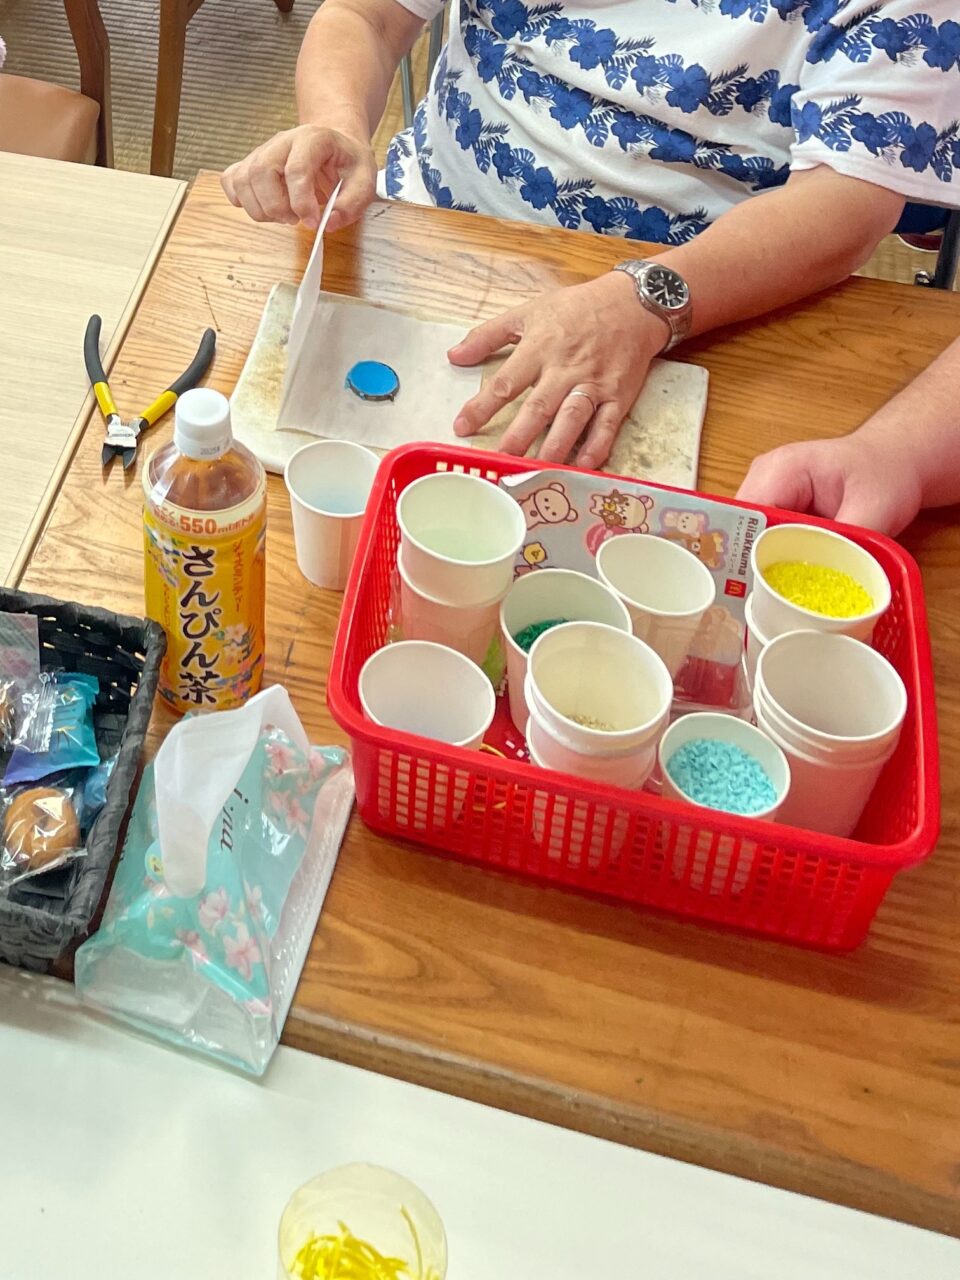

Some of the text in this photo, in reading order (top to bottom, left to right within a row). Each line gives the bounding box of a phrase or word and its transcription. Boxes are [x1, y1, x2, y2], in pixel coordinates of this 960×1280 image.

[738, 516, 759, 576] Rilakkuma
[179, 545, 224, 705] さんぴん茶
